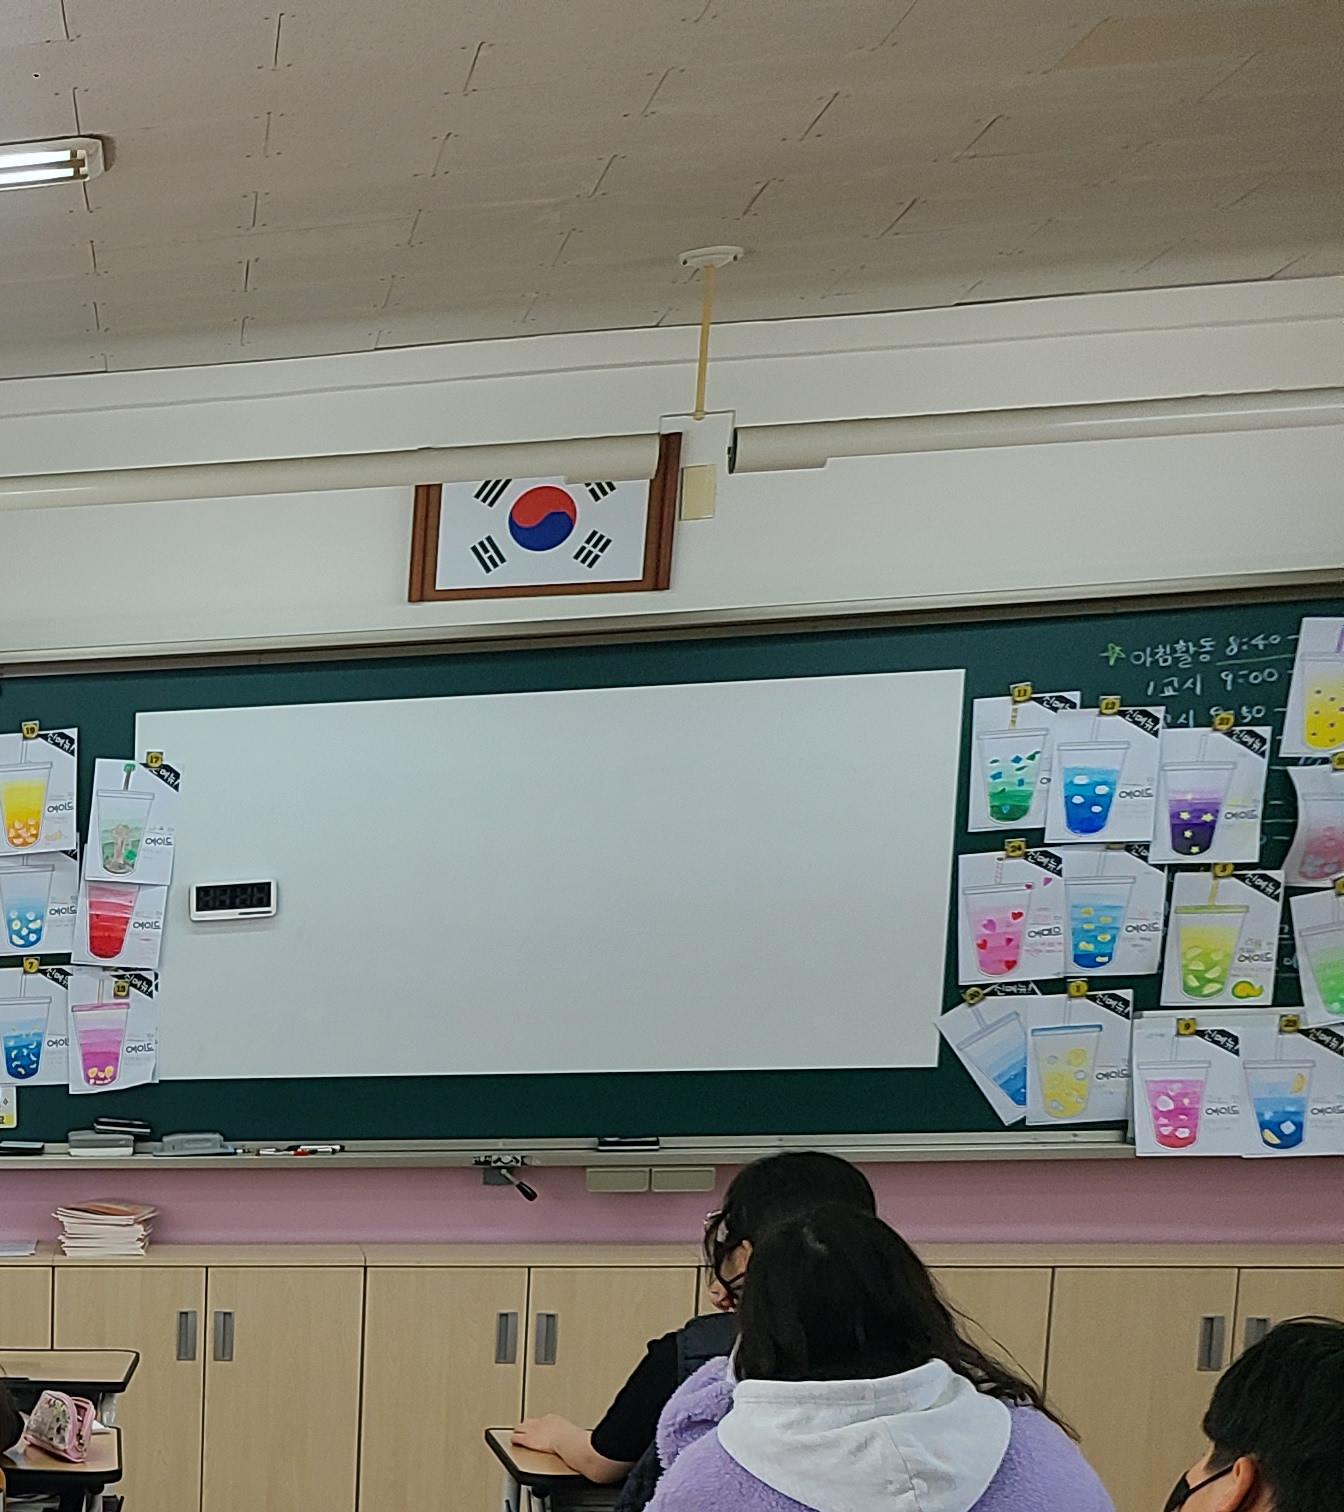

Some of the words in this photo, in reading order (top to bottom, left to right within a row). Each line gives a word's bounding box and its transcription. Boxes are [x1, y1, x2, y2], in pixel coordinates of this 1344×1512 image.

[1130, 637, 1215, 669] 아침활동
[1225, 634, 1281, 656] 8:40
[1220, 668, 1278, 691] 9:00
